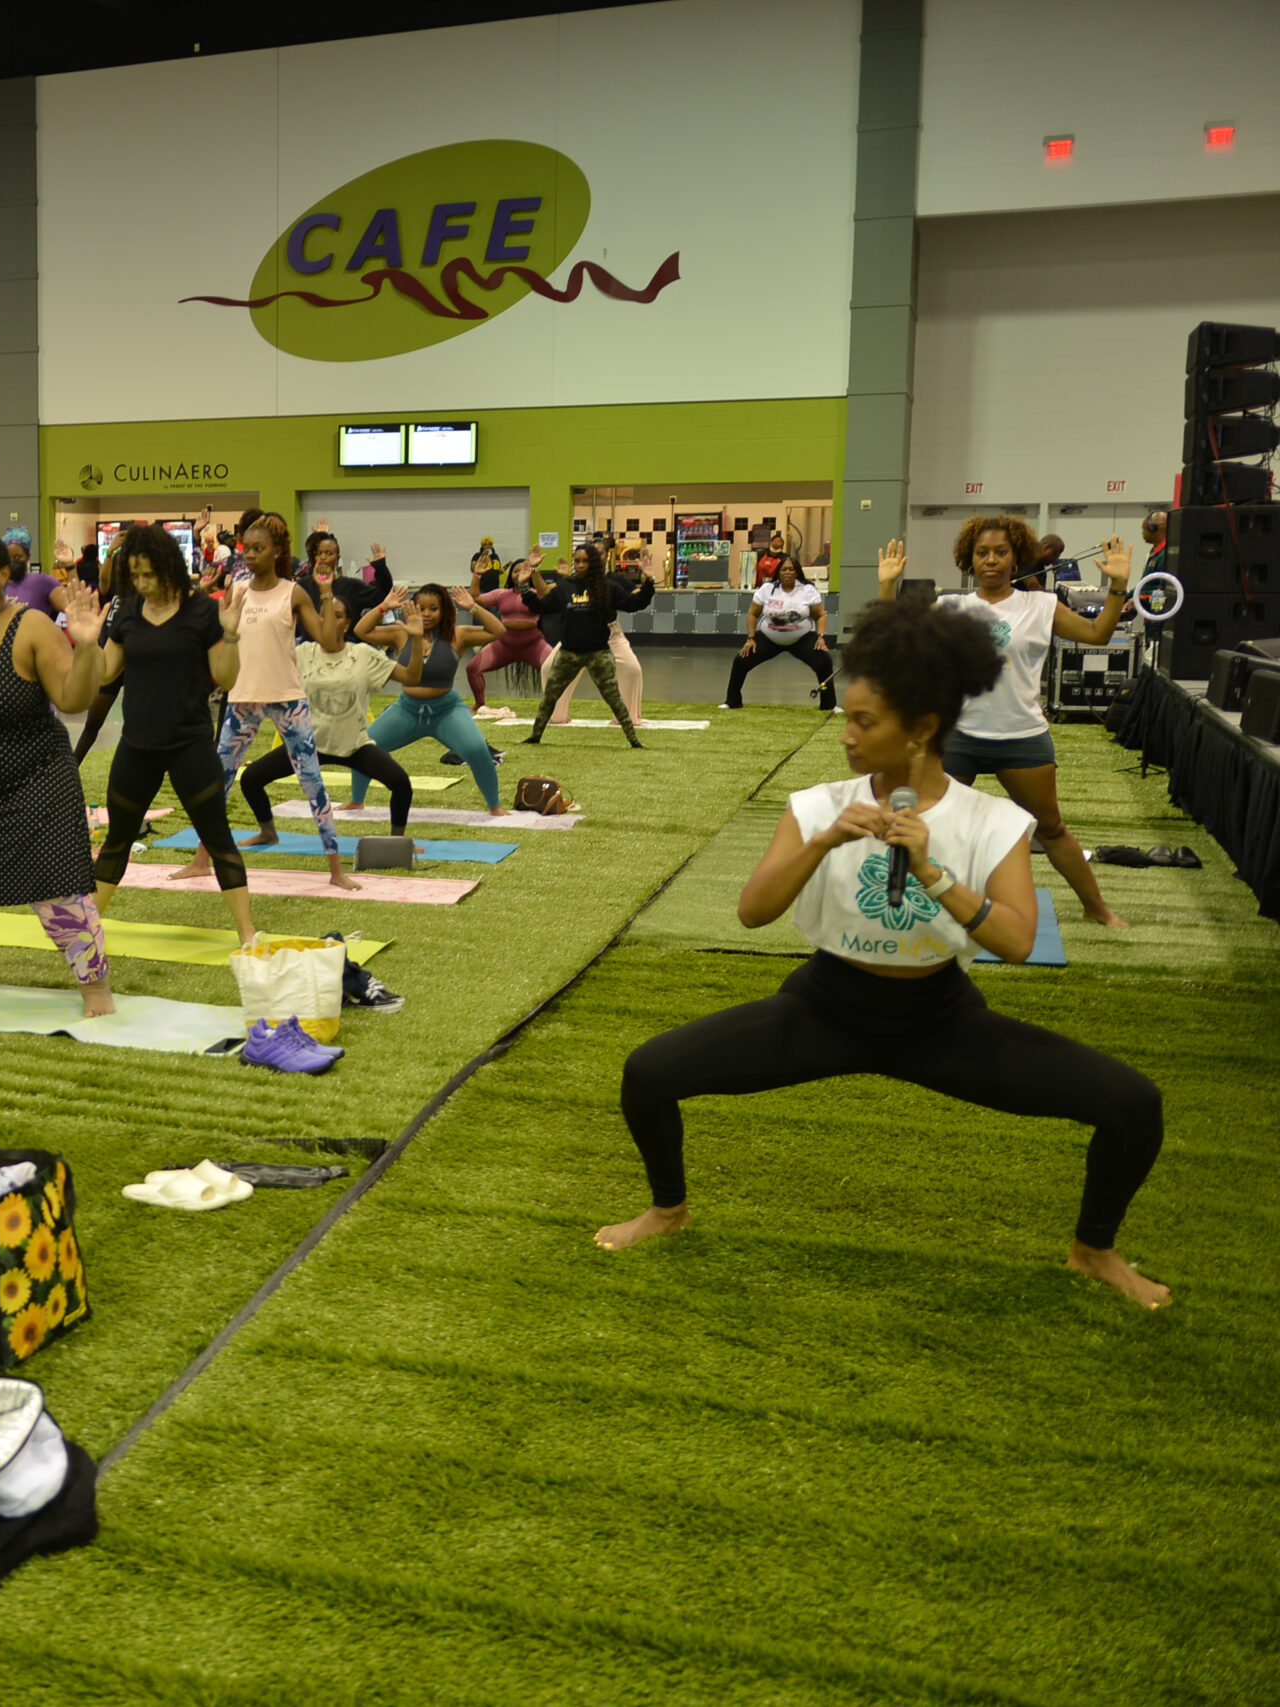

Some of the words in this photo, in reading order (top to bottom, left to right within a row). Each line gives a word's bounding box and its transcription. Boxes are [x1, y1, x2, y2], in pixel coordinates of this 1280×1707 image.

[286, 196, 543, 275] CAFE
[965, 483, 984, 494] EXIT
[1107, 480, 1126, 492] EXIT
